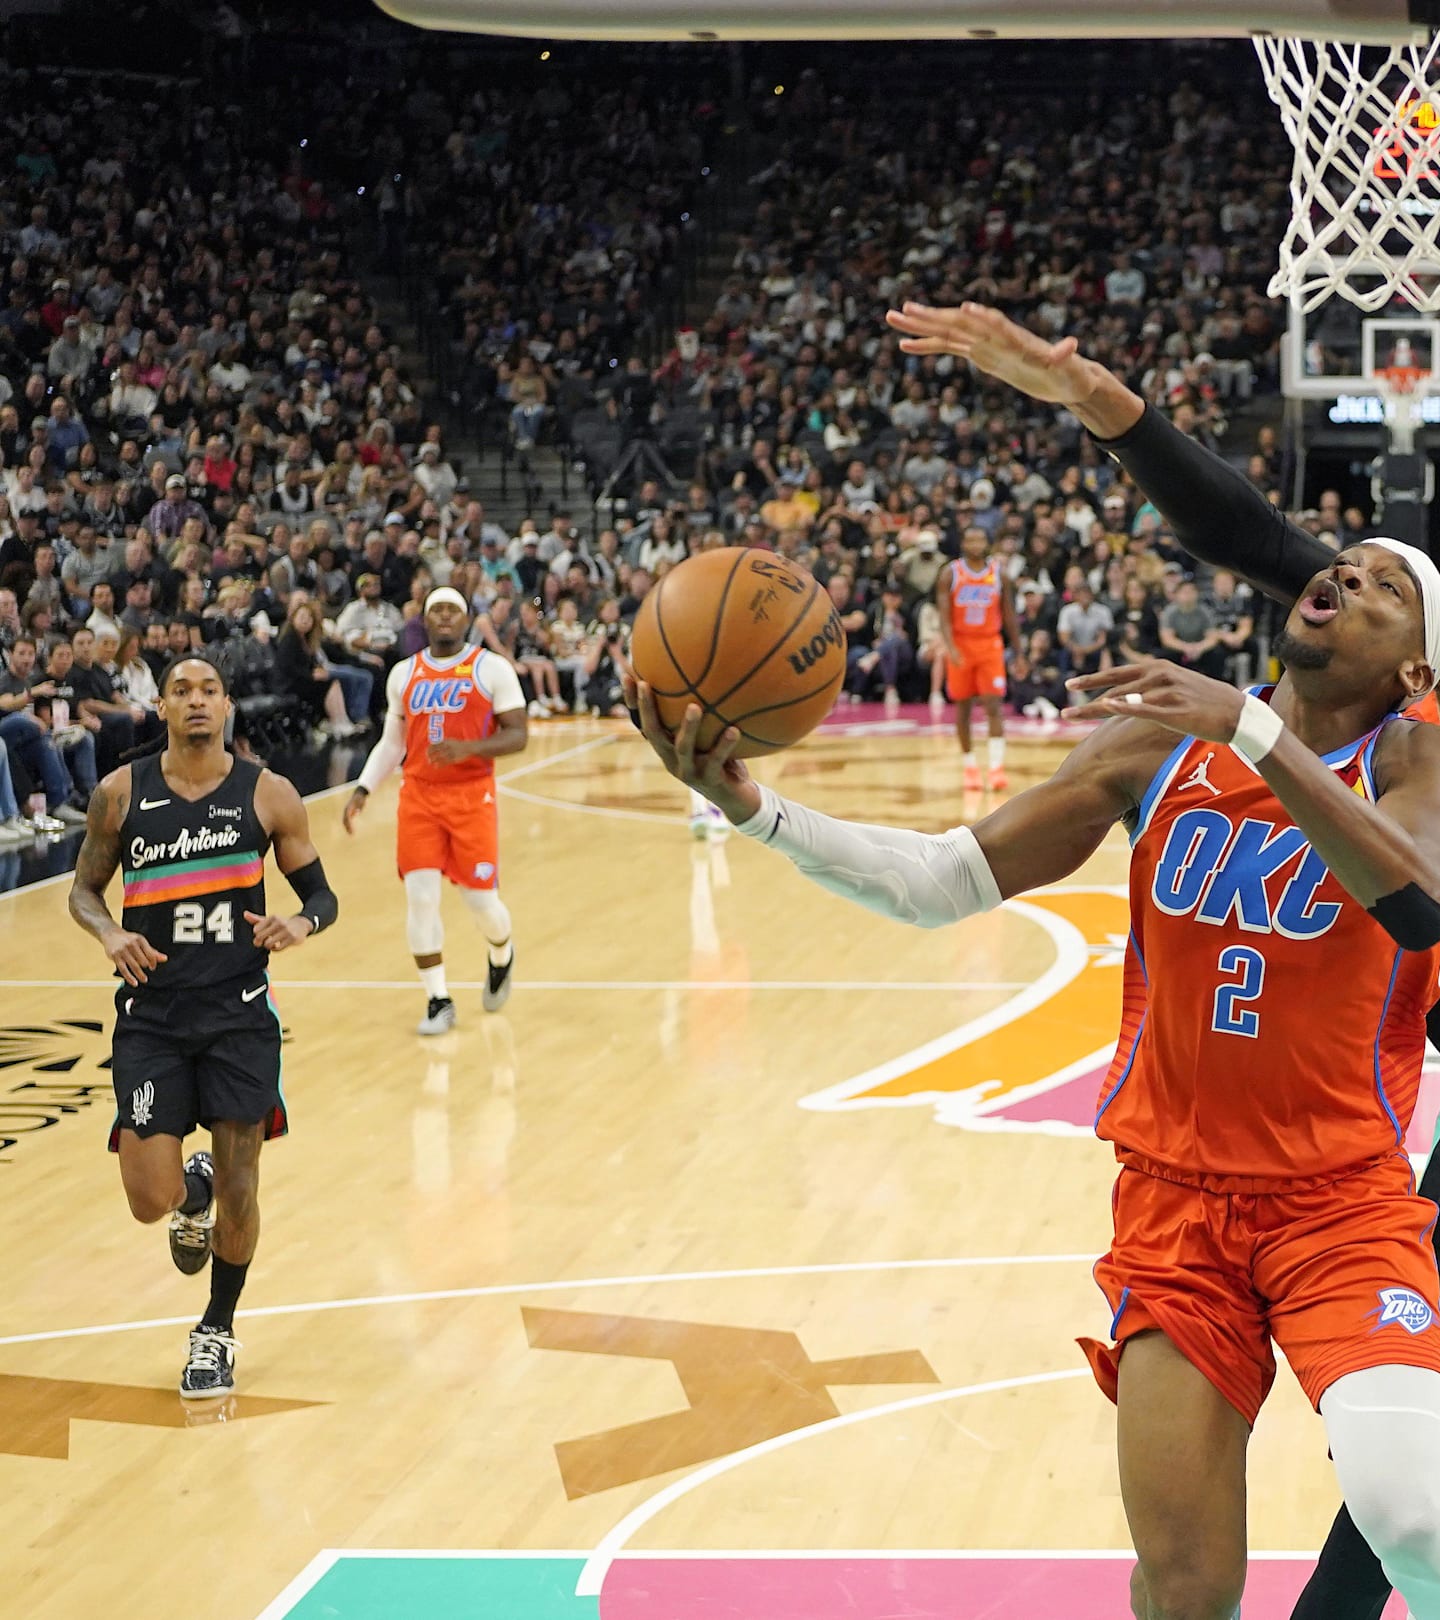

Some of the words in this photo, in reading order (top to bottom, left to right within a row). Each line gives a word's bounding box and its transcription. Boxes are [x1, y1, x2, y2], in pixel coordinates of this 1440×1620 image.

[788, 606, 844, 675] lson
[410, 678, 473, 716] OKC
[428, 713, 444, 744] 5
[131, 836, 167, 869] San
[167, 824, 241, 860] Antonio
[1151, 808, 1343, 940] OKC
[172, 900, 235, 945] 24
[1211, 945, 1266, 1038] 2
[1380, 1299, 1425, 1321] OKC
